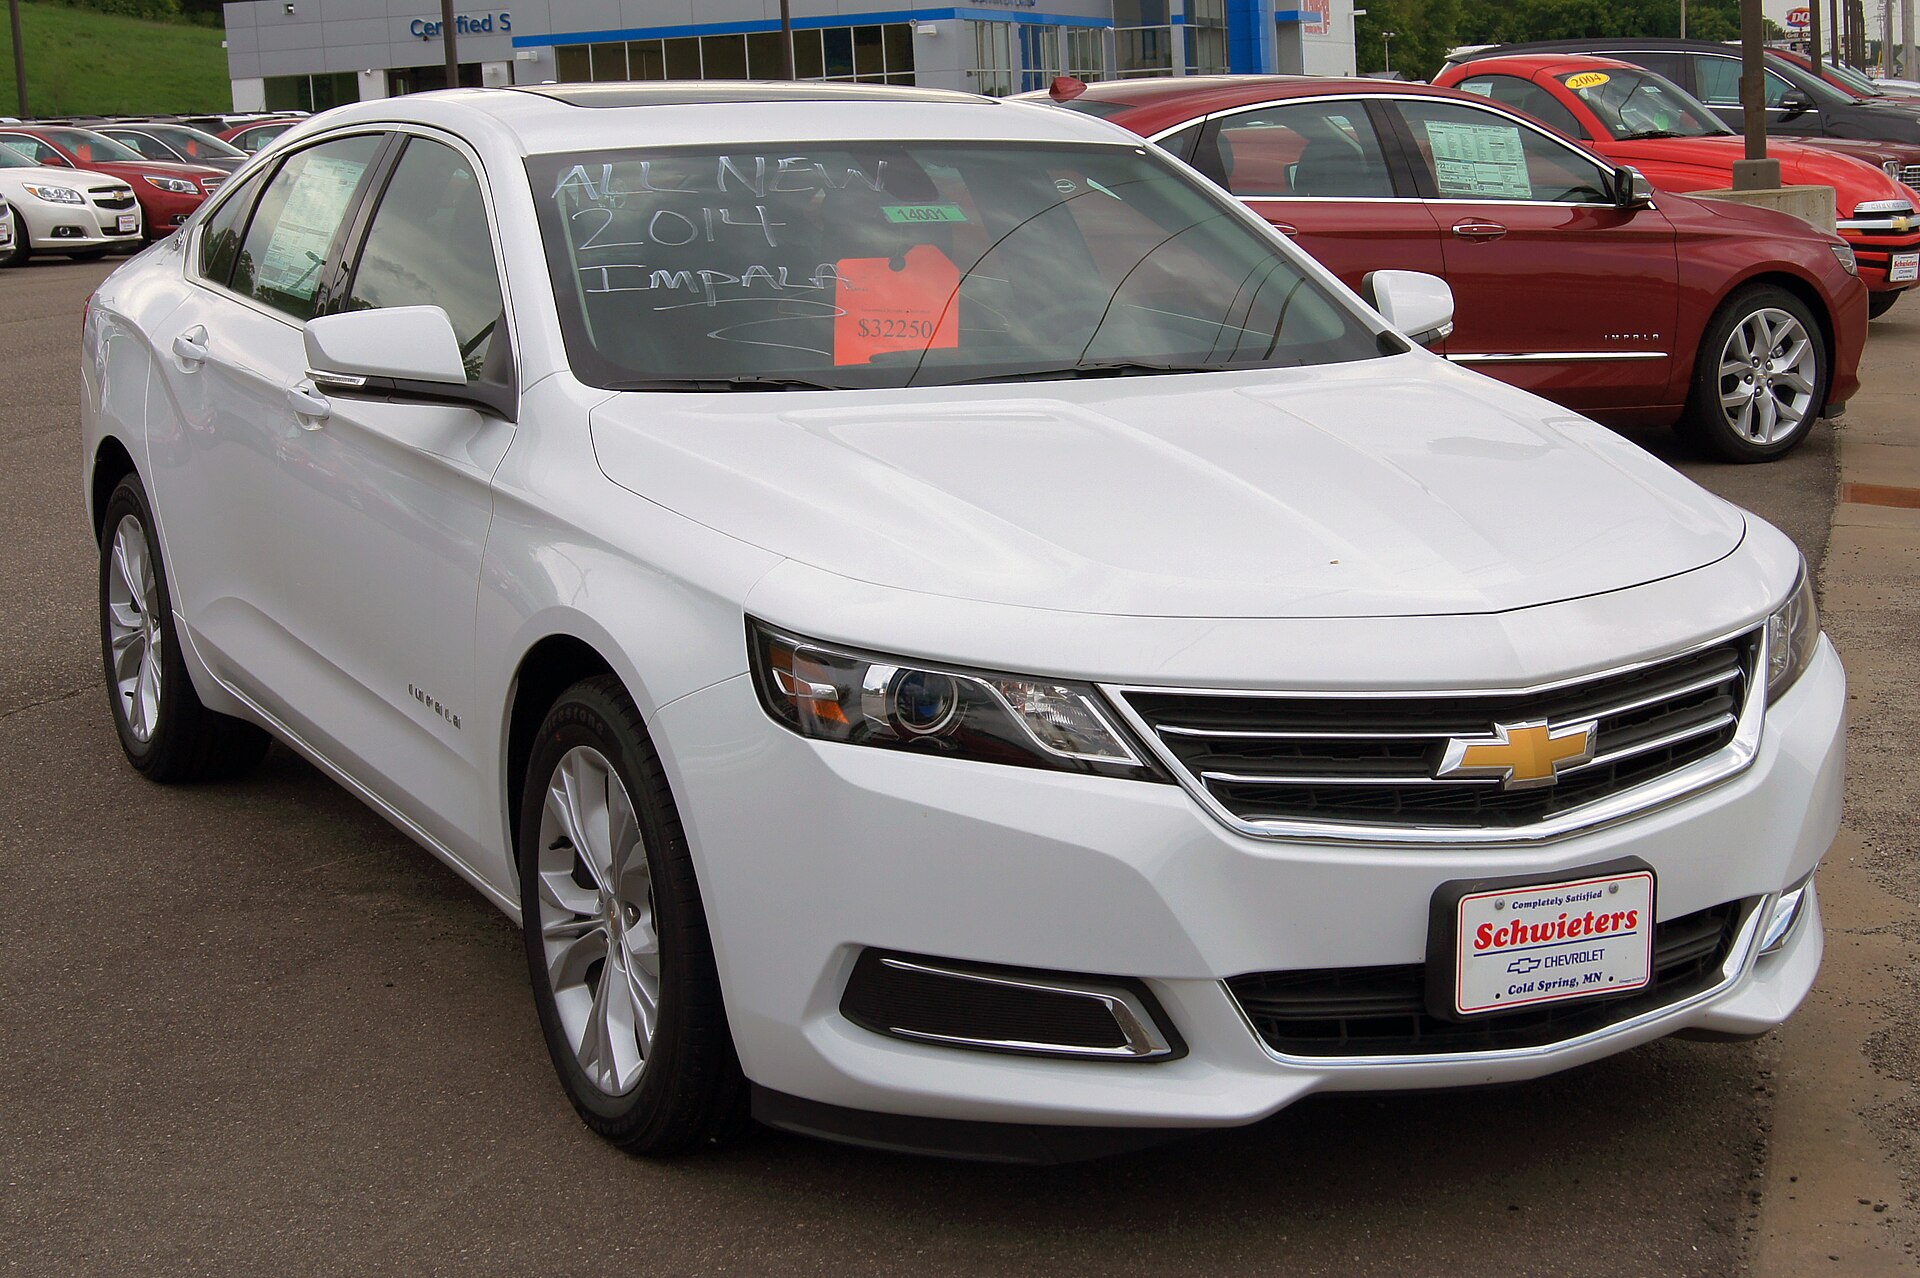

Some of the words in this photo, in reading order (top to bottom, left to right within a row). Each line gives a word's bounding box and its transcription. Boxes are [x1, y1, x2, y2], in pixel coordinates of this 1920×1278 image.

[410, 13, 492, 36] Cerfied
[1792, 12, 1810, 23] DQ
[1571, 73, 1601, 87] 2004
[551, 162, 698, 200] ALL
[717, 156, 888, 197] NEW
[897, 208, 948, 221] 14001
[572, 205, 786, 249] 2014
[858, 319, 933, 338] $32250
[408, 683, 461, 730] IMPALA
[1512, 896, 1563, 910] Completely
[1566, 890, 1602, 904] Satisfied
[1474, 909, 1638, 950] Schwieters
[1544, 948, 1605, 968] CHEVROLET
[1508, 983, 1534, 995] Cold
[1537, 977, 1579, 992] Spring,
[1582, 971, 1602, 984] MN
